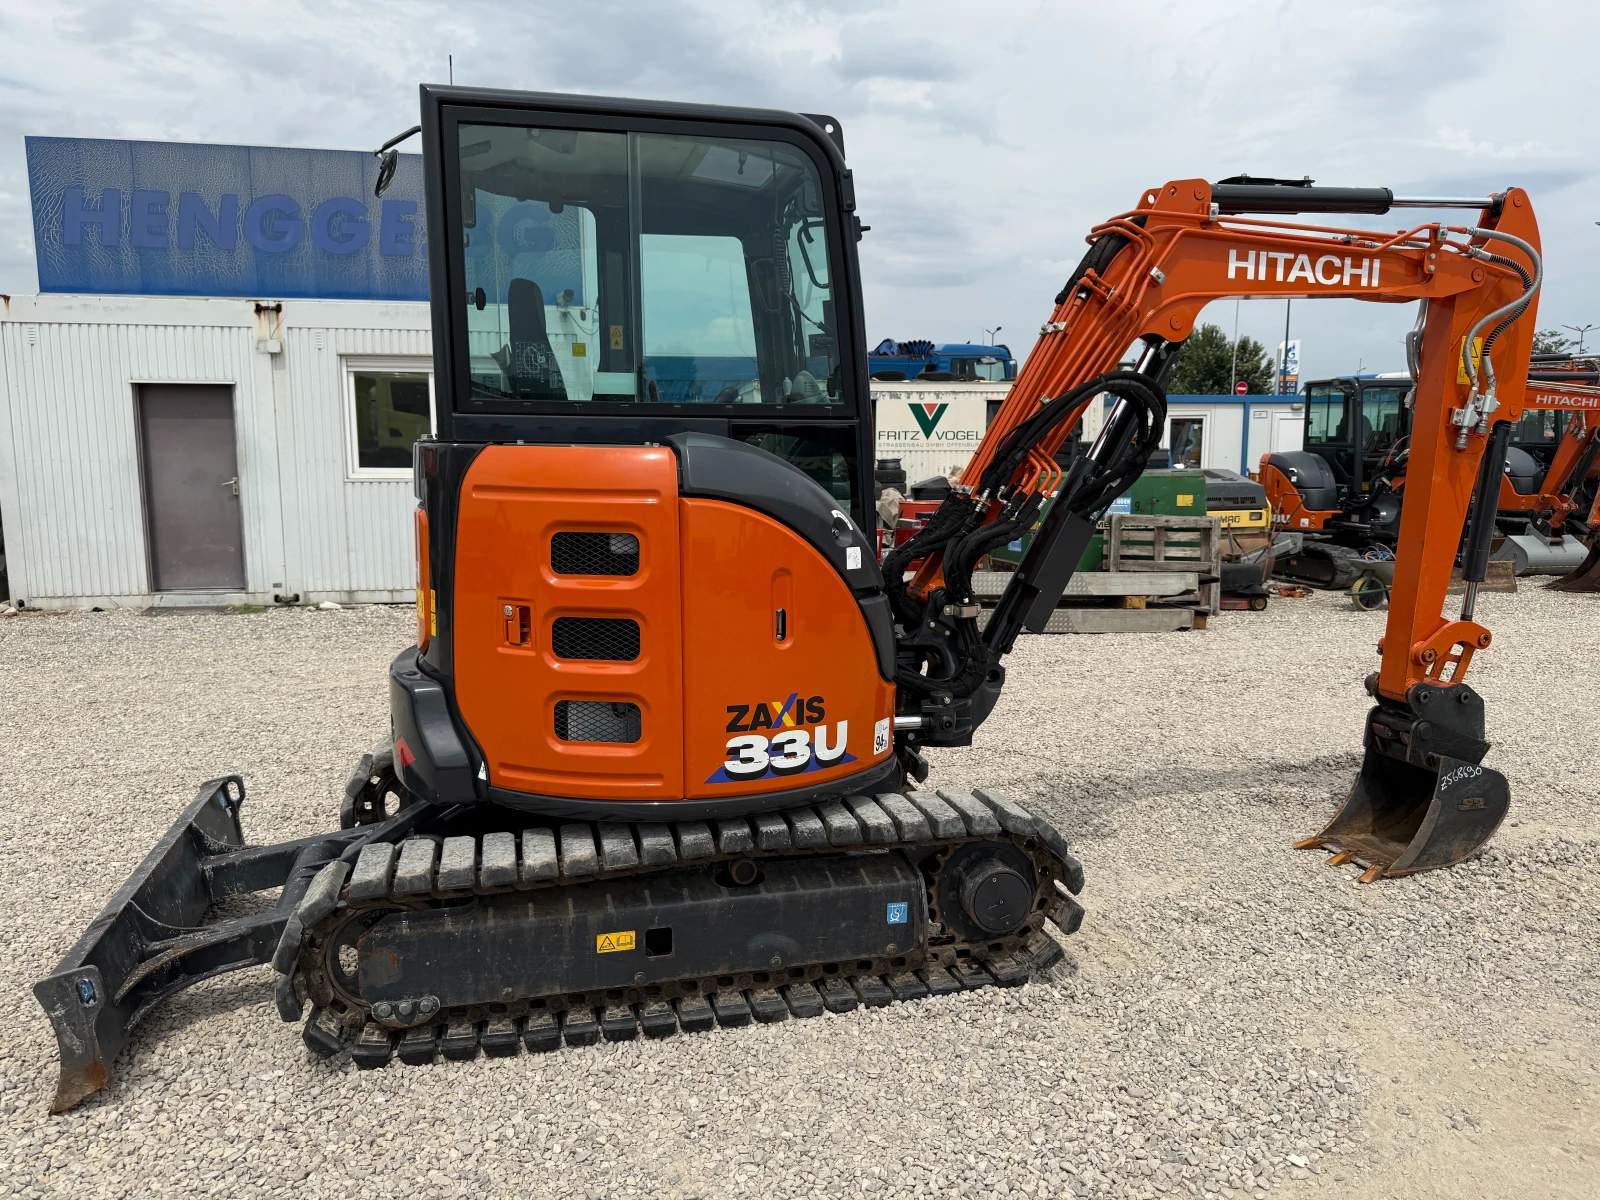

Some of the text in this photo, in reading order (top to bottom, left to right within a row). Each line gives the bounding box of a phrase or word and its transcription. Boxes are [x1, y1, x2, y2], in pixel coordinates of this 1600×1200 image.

[1227, 249, 1380, 288] HITACHI
[1535, 394, 1598, 408] HITACHI
[878, 430, 983, 441] FRITZ VOGEL
[1220, 515, 1241, 523] MAG
[726, 693, 825, 733] ZAXIS
[724, 720, 848, 781] 33U
[875, 734, 884, 751] 94
